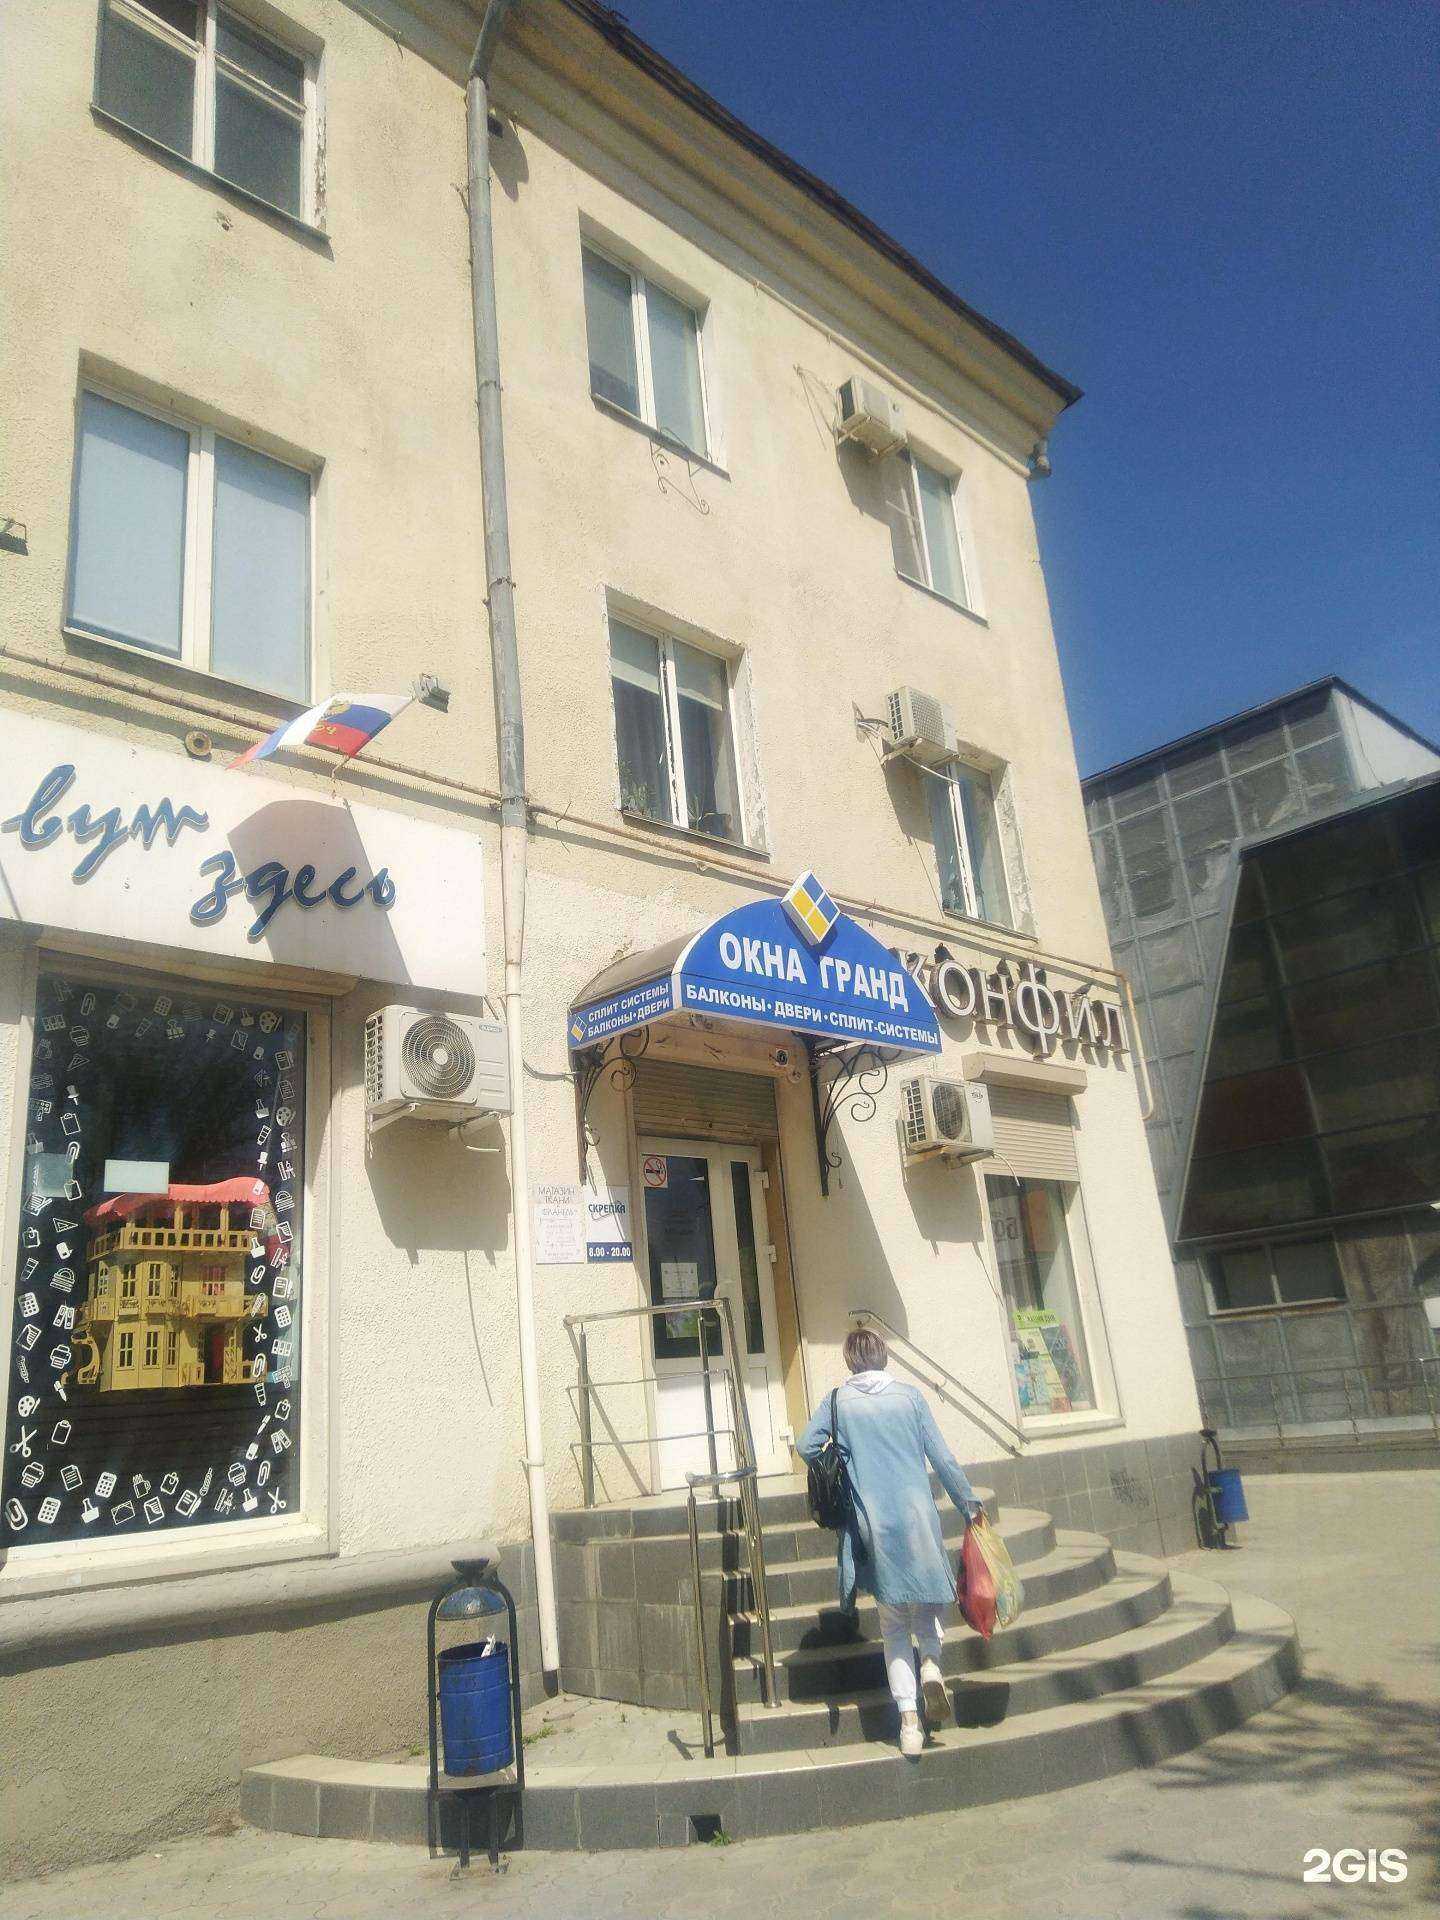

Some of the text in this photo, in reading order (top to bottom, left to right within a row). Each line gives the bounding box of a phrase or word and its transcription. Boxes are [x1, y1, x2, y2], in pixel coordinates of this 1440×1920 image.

[190, 850, 397, 944] здесь
[719, 932, 909, 1012] ОКНА ГРАНД
[587, 998, 670, 1037] БАЛКОНЫ ДВЕРИ
[588, 983, 669, 1022] СПЛИТ СИСТЕМЫ
[686, 984, 939, 1045] БАЛКОНЫ ДВЕРИ СПЛИТ-СИСТЕМЫ
[538, 1186, 575, 1195] МАГАЗИН
[545, 1196, 570, 1204] ТКАНИ
[588, 1202, 626, 1214] СКРЕПКА
